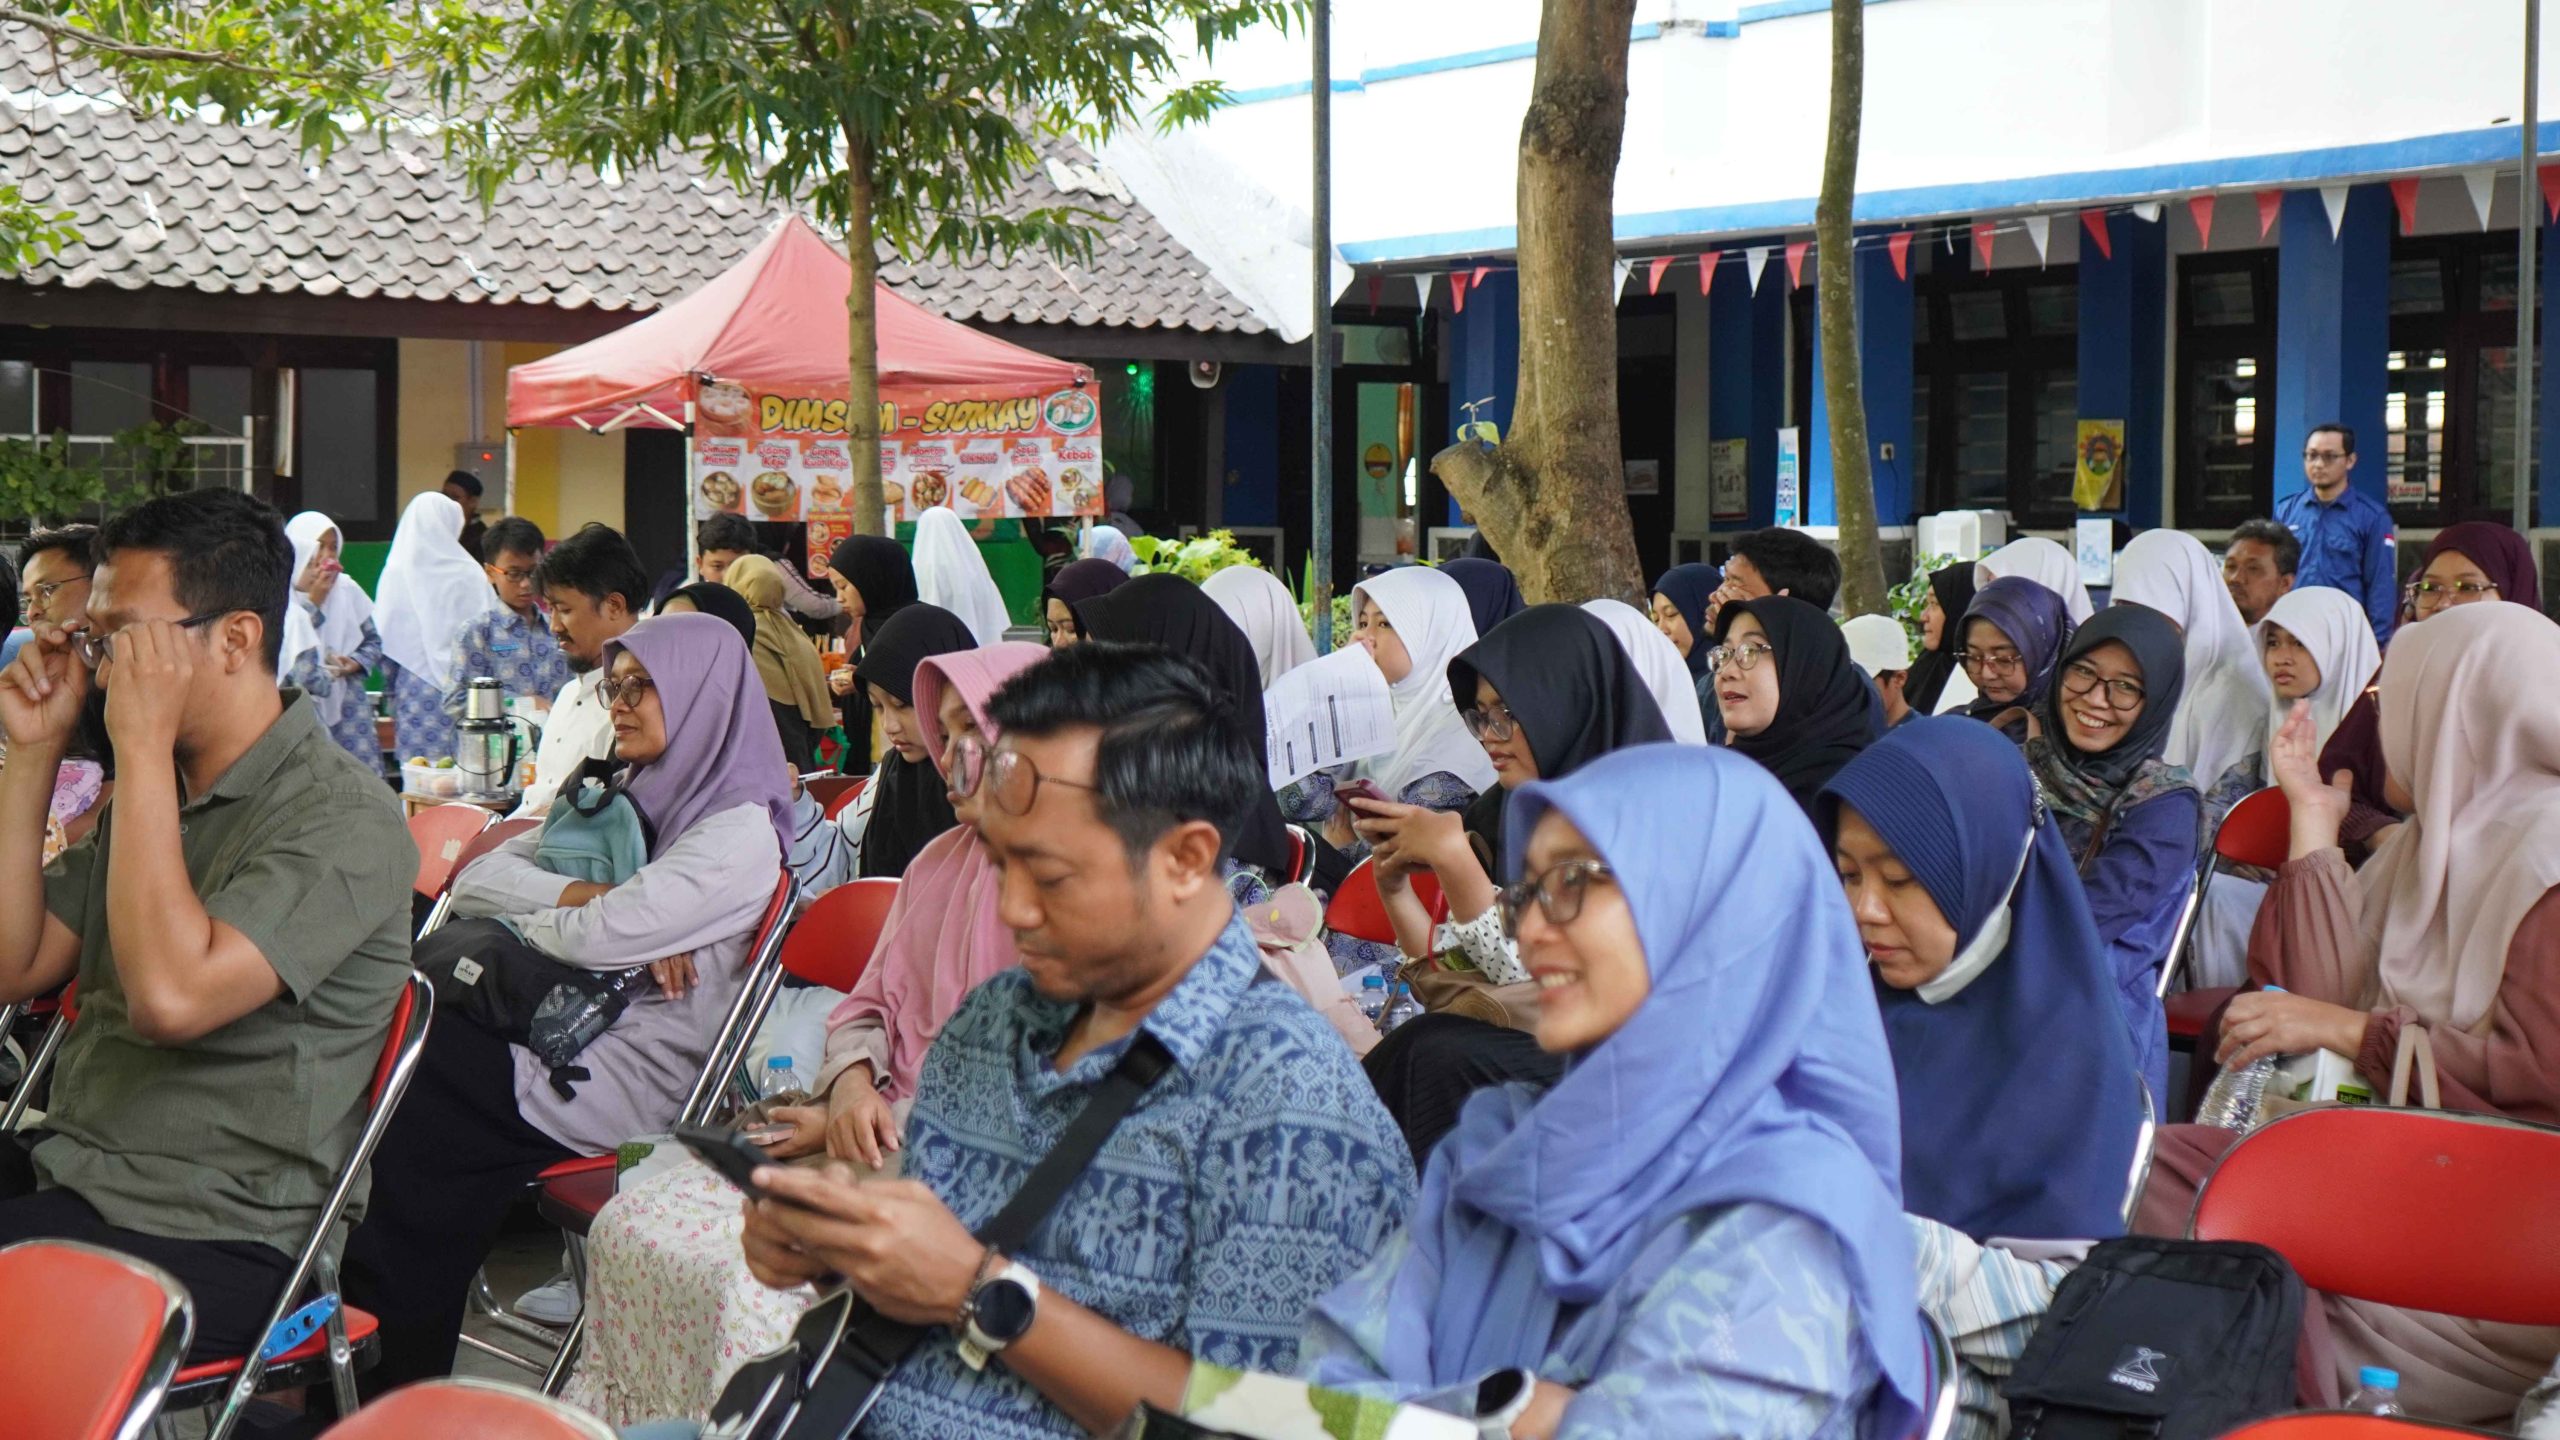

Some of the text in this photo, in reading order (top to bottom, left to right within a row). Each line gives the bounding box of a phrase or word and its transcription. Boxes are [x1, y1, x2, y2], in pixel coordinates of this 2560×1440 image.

[760, 395, 898, 434] DIMSM
[922, 397, 1041, 433] SIOMAY
[1057, 447, 1095, 460] Kebab
